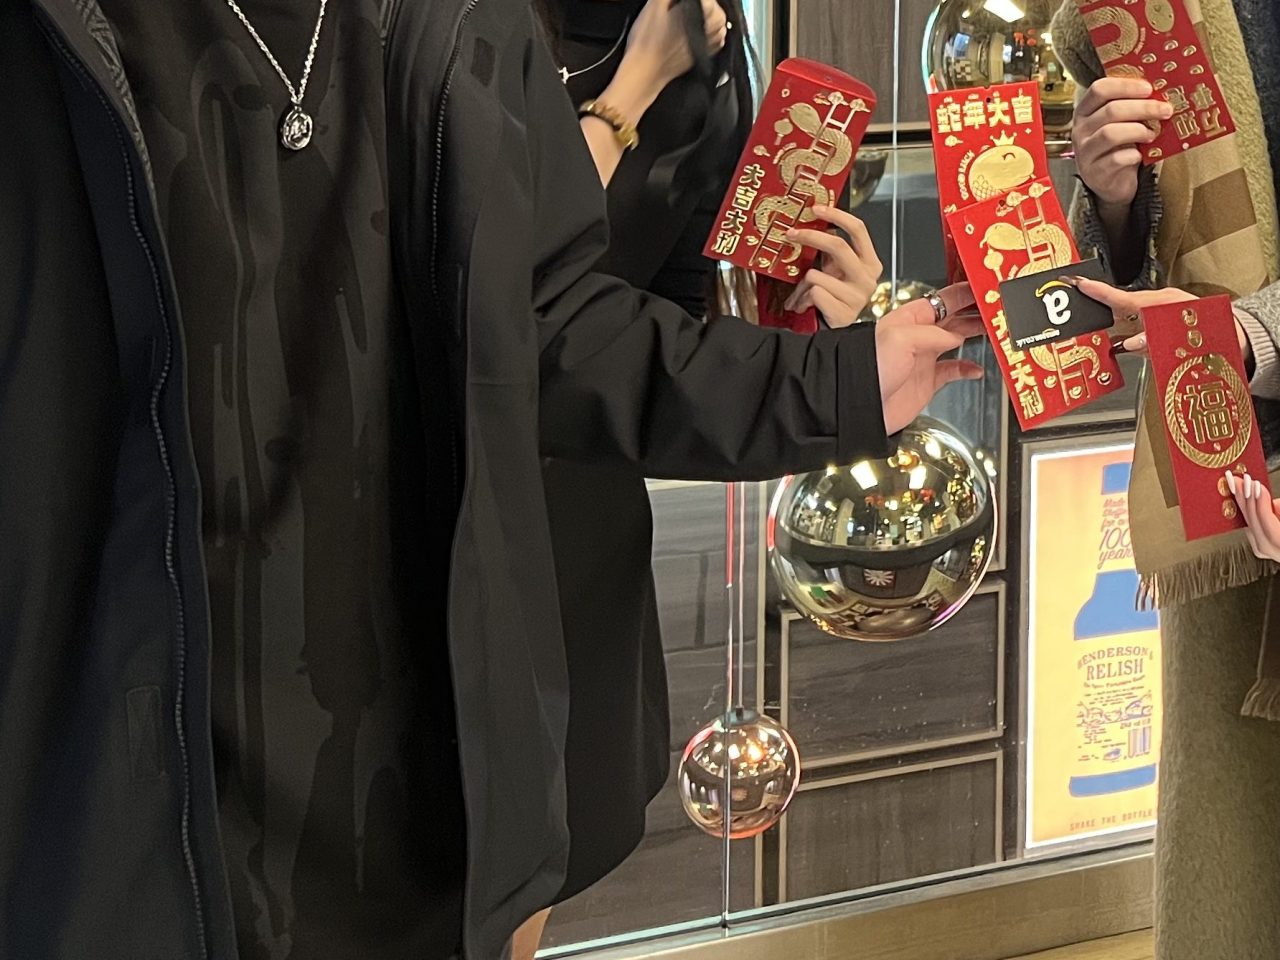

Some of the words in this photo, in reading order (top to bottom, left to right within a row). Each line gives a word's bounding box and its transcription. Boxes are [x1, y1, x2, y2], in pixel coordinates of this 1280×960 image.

[936, 88, 1034, 133] 蛇年大吉
[711, 163, 765, 256] 大吉大利
[1184, 381, 1235, 443] 福
[1087, 658, 1143, 680] RELISH
